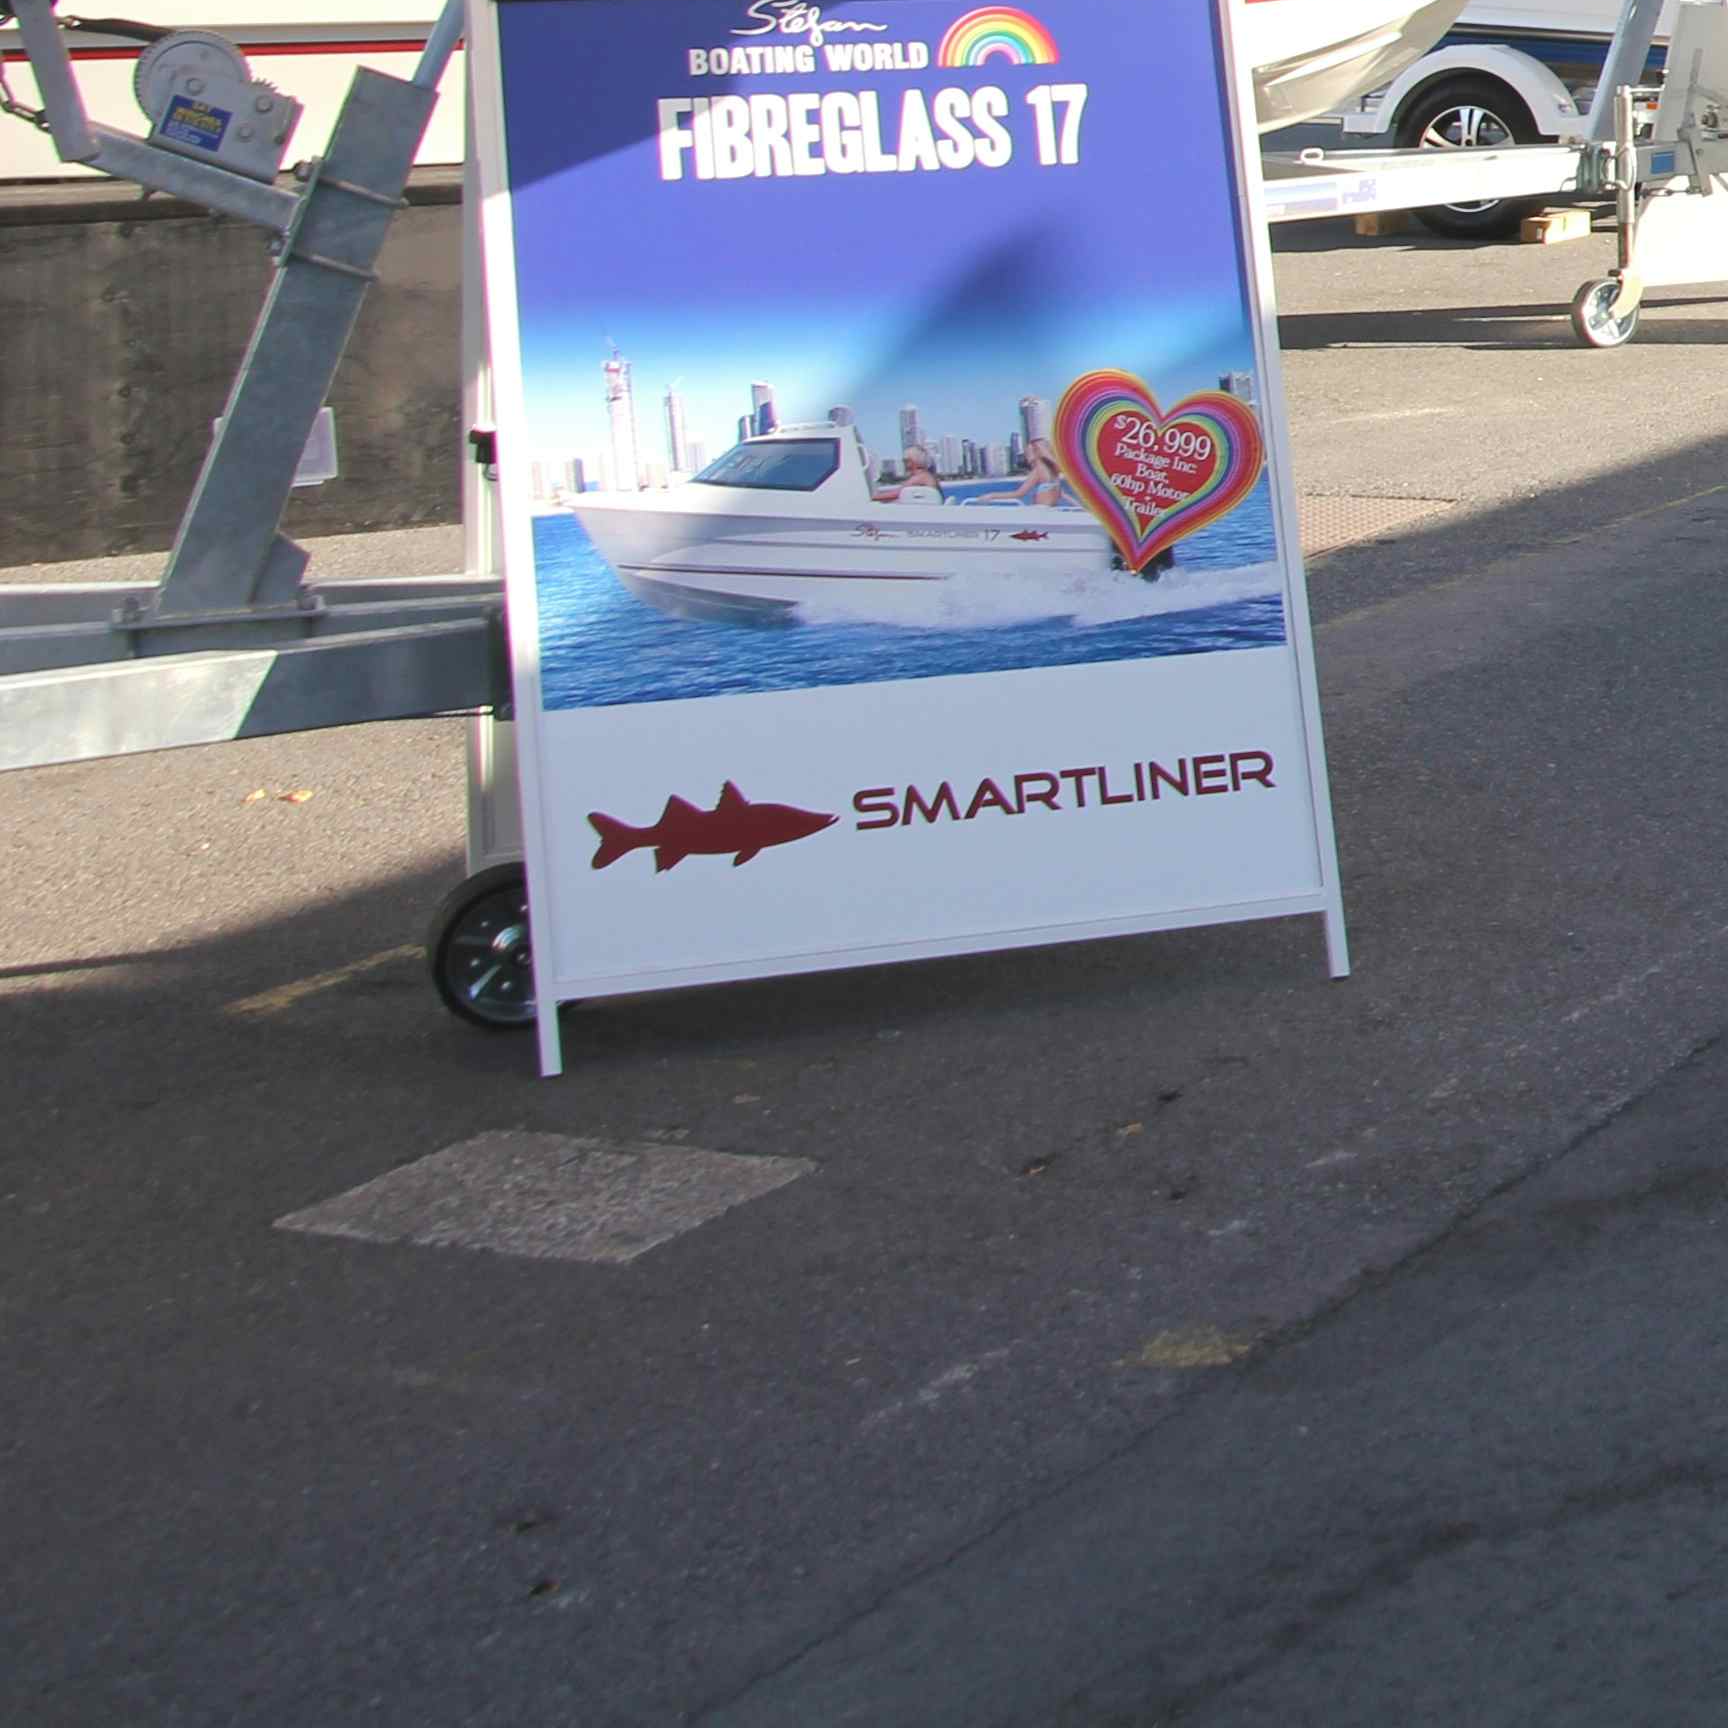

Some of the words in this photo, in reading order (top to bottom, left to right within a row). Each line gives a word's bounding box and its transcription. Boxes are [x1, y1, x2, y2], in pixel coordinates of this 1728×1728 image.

[688, 44, 816, 76] BOATING
[824, 42, 929, 71] WORLD
[658, 85, 1013, 180] FIBREGLASS
[1025, 83, 1088, 166] 17
[1114, 442, 1170, 469] Package
[852, 749, 1277, 831] SMARTLINER
